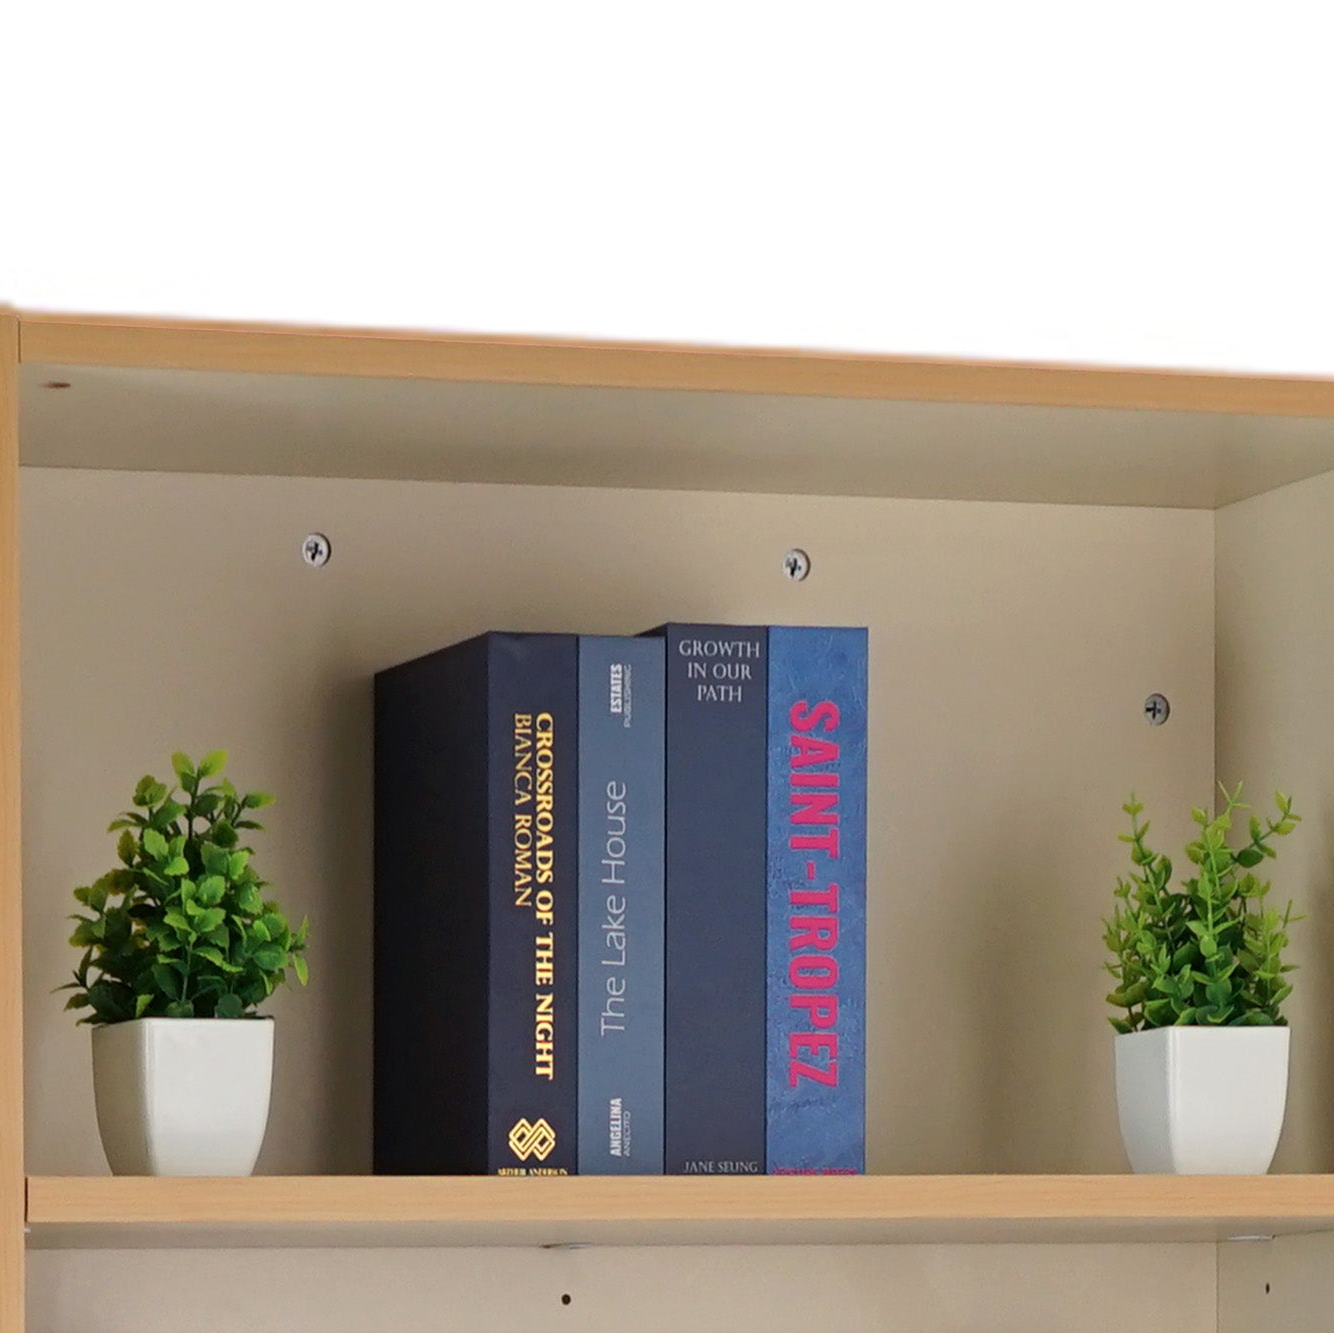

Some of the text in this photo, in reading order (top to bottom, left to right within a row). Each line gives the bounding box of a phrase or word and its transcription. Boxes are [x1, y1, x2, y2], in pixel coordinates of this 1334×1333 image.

[679, 640, 759, 657] GROWTH
[688, 662, 751, 679] IN OUR
[611, 664, 622, 713] ESTATES
[698, 685, 741, 702] PATH
[515, 714, 532, 906] BIANCA ROMAN
[536, 713, 553, 1080] CROSSROADS OF THE NIGHT
[601, 781, 626, 1036] The Lake House
[610, 1098, 621, 1156] ANGELINA
[684, 1161, 714, 1172] JANE
